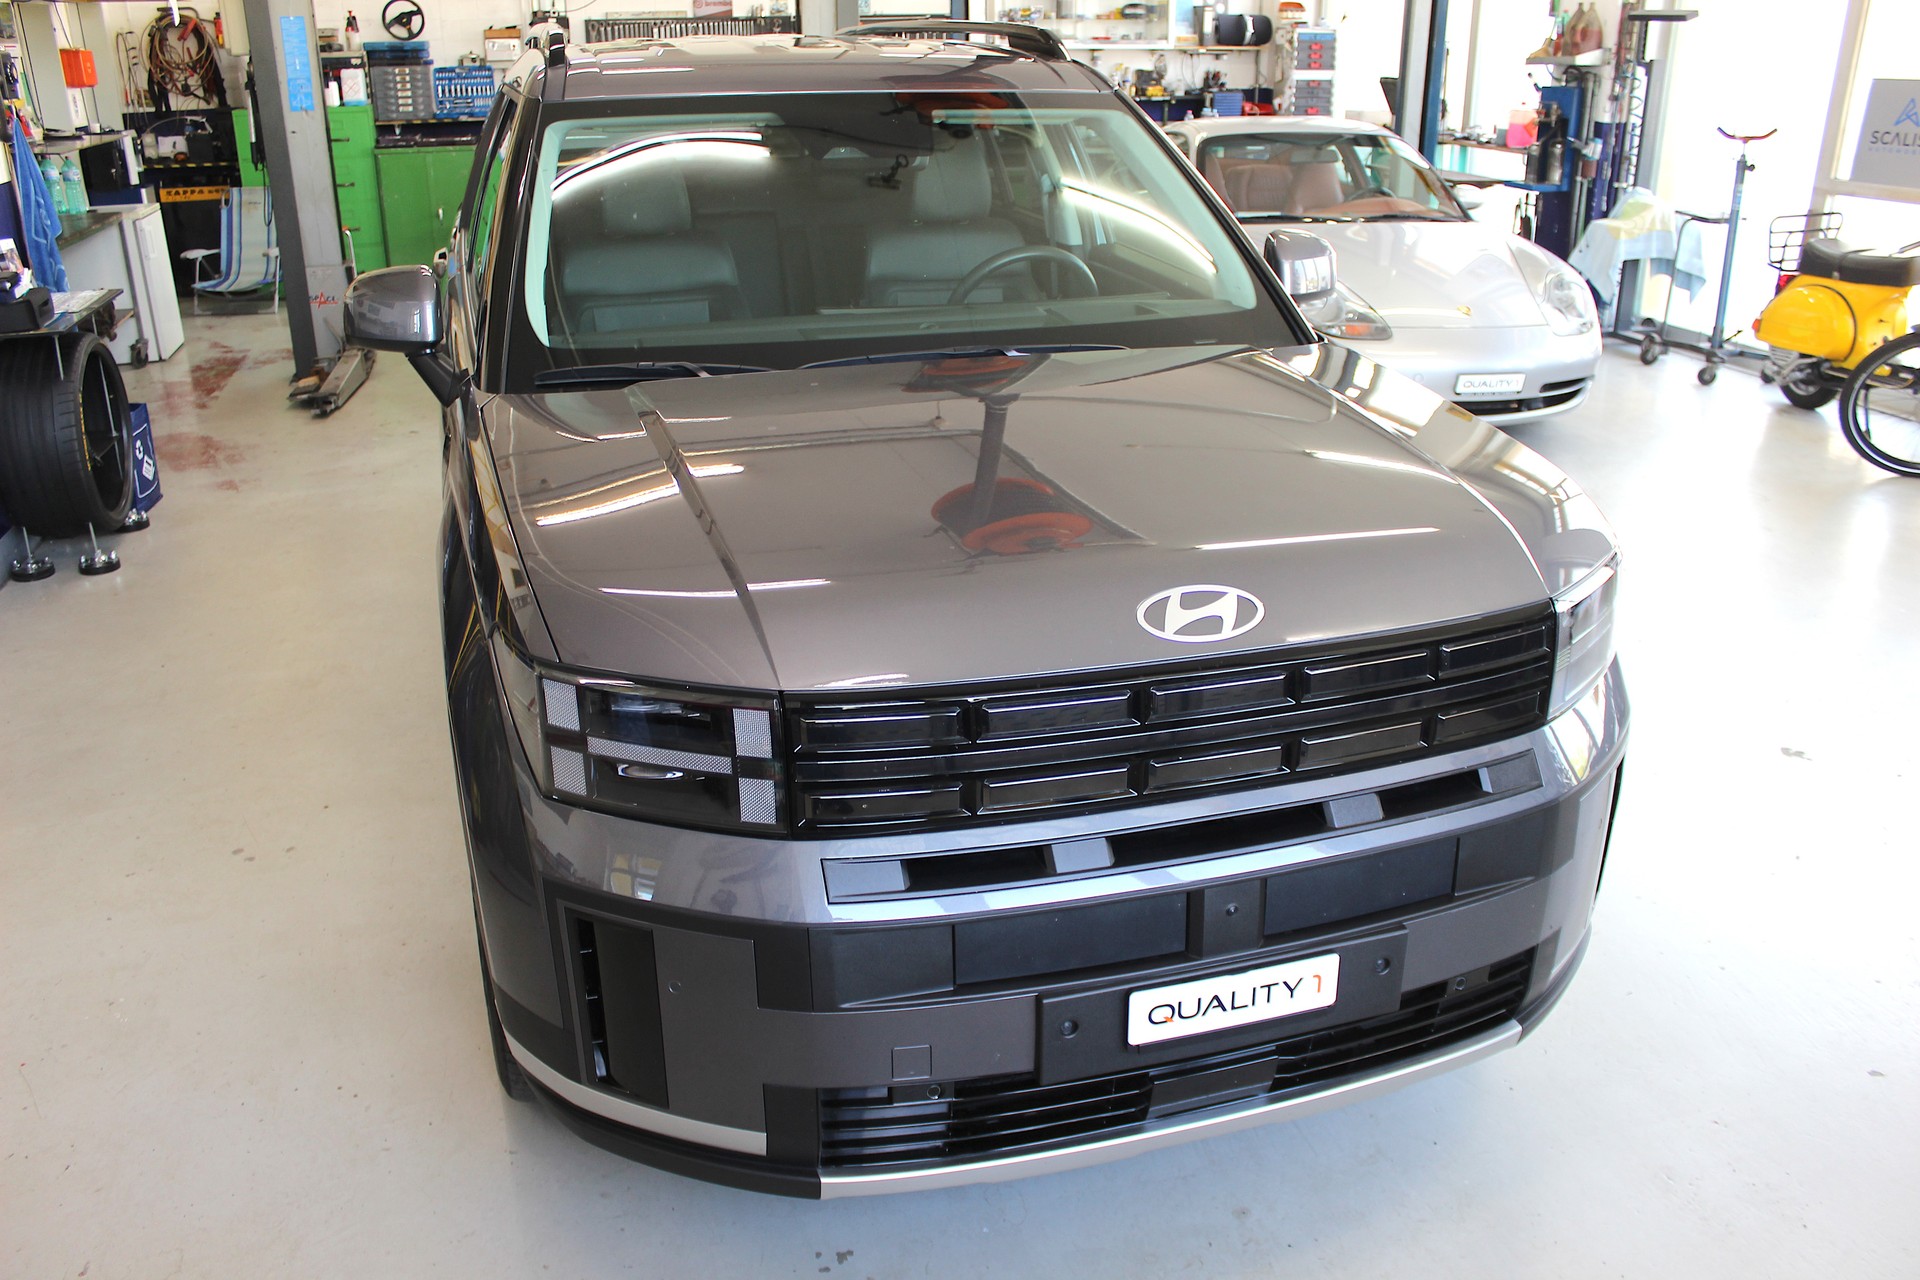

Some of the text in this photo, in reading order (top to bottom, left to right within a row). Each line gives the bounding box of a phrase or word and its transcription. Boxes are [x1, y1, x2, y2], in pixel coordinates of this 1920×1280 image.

[1463, 379, 1513, 389] QUALITY
[1148, 974, 1323, 1025] QUALITY 1
